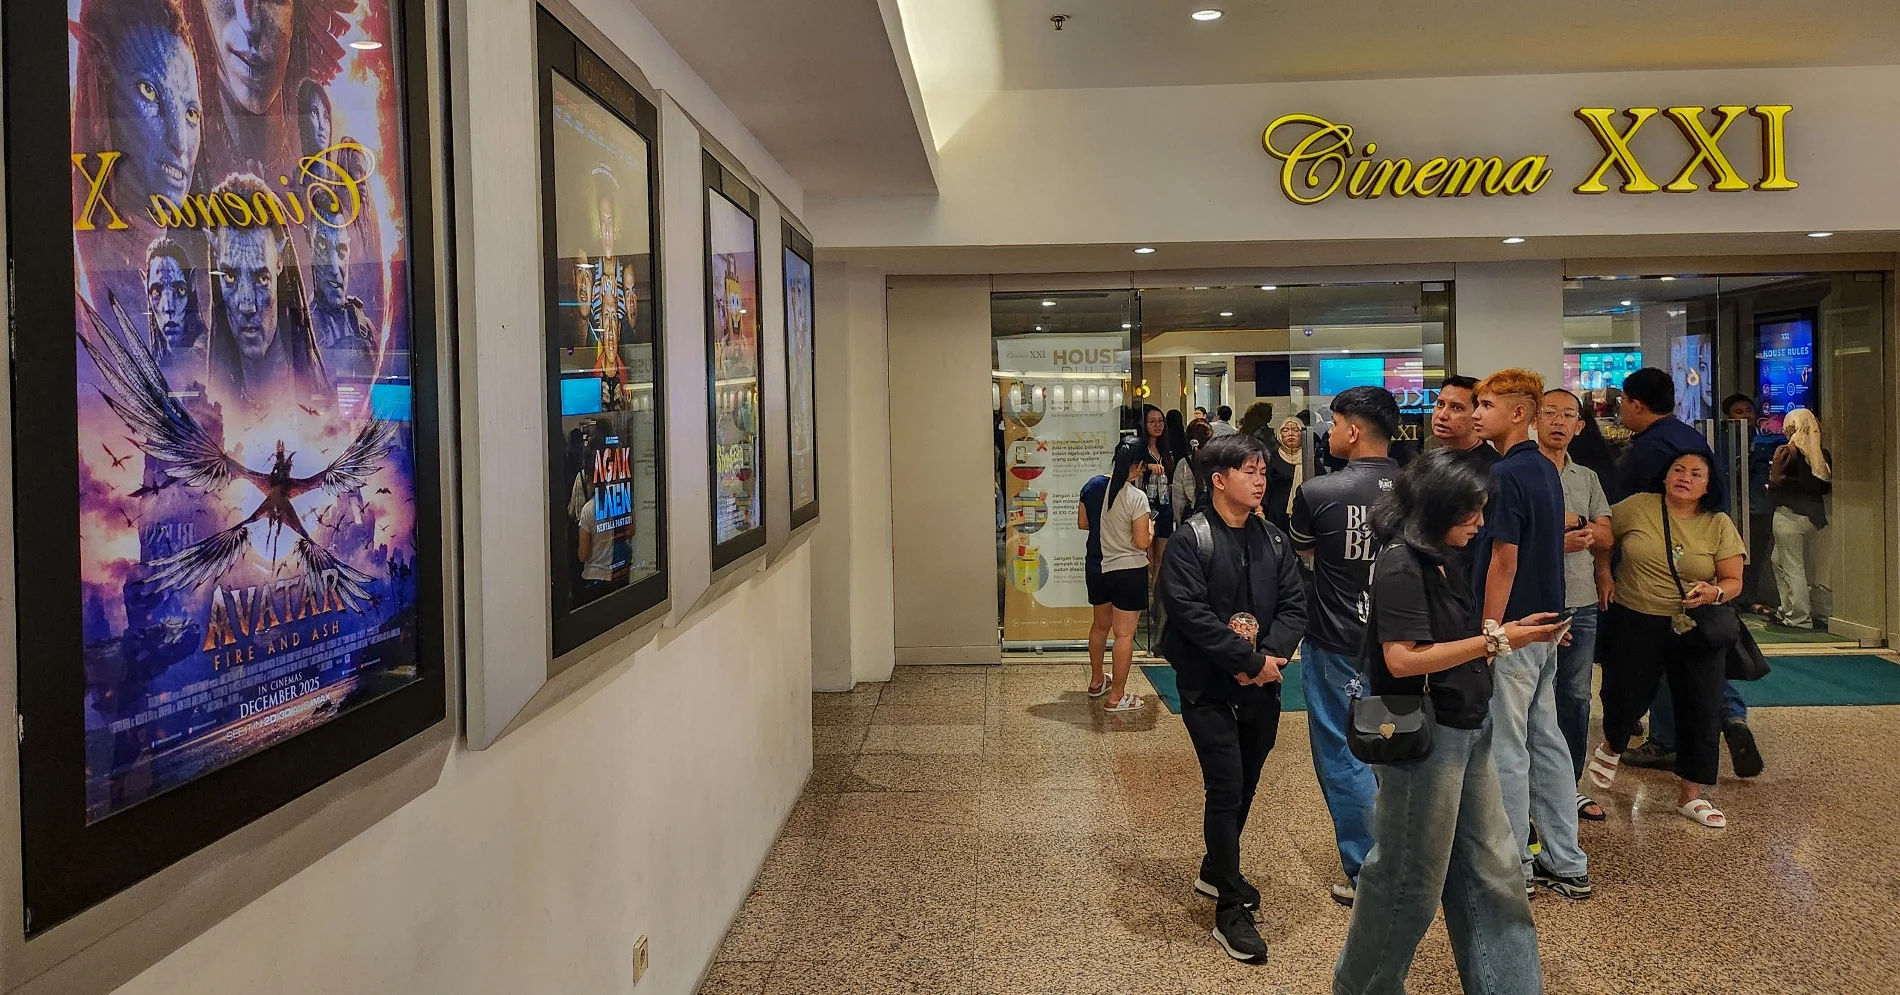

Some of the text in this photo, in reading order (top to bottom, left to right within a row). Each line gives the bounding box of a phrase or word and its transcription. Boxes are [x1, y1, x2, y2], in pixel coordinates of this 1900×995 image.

[1262, 104, 1800, 205] Cinema XXI
[1029, 350, 1046, 359] XXI
[1053, 348, 1122, 366] HOUSE
[1763, 346, 1810, 358] HOUSE RULES
[593, 447, 632, 484] AGAK
[203, 568, 347, 652] AVATAR
[213, 645, 255, 671] FIRE
[267, 632, 300, 655] AND
[312, 619, 341, 641] ASH
[239, 682, 299, 719] DECEMBER
[299, 676, 320, 697] 2025
[258, 671, 303, 696] IN CINEMAS
[226, 728, 245, 741] SEE
[244, 722, 253, 733] IT
[253, 720, 263, 729] IN
[263, 713, 277, 725] 2D
[310, 692, 332, 706] IMAX
